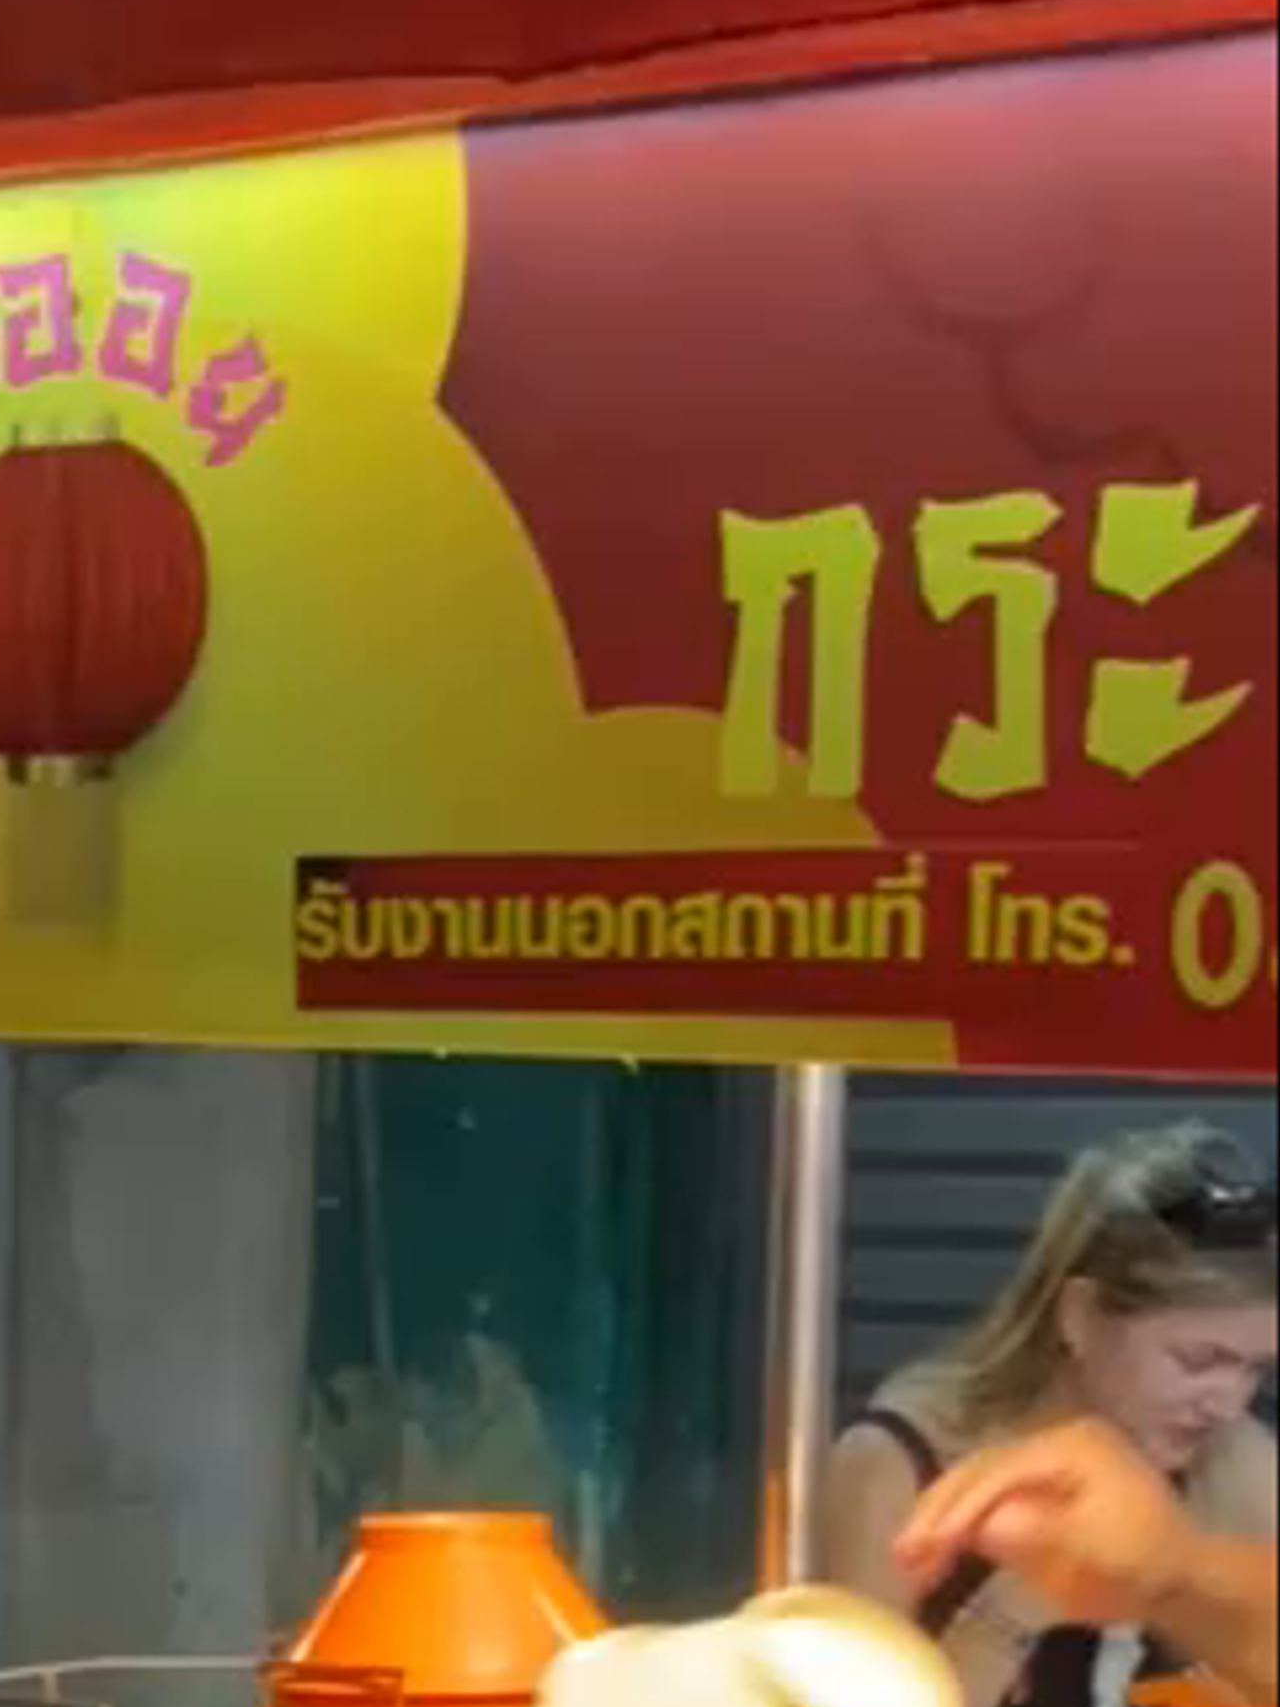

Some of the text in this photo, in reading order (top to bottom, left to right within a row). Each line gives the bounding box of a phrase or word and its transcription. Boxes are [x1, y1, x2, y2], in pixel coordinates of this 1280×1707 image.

[718, 477, 1264, 801] กระ
[296, 853, 1278, 1008] รับงานนอกสถานที่ โทร. 0
